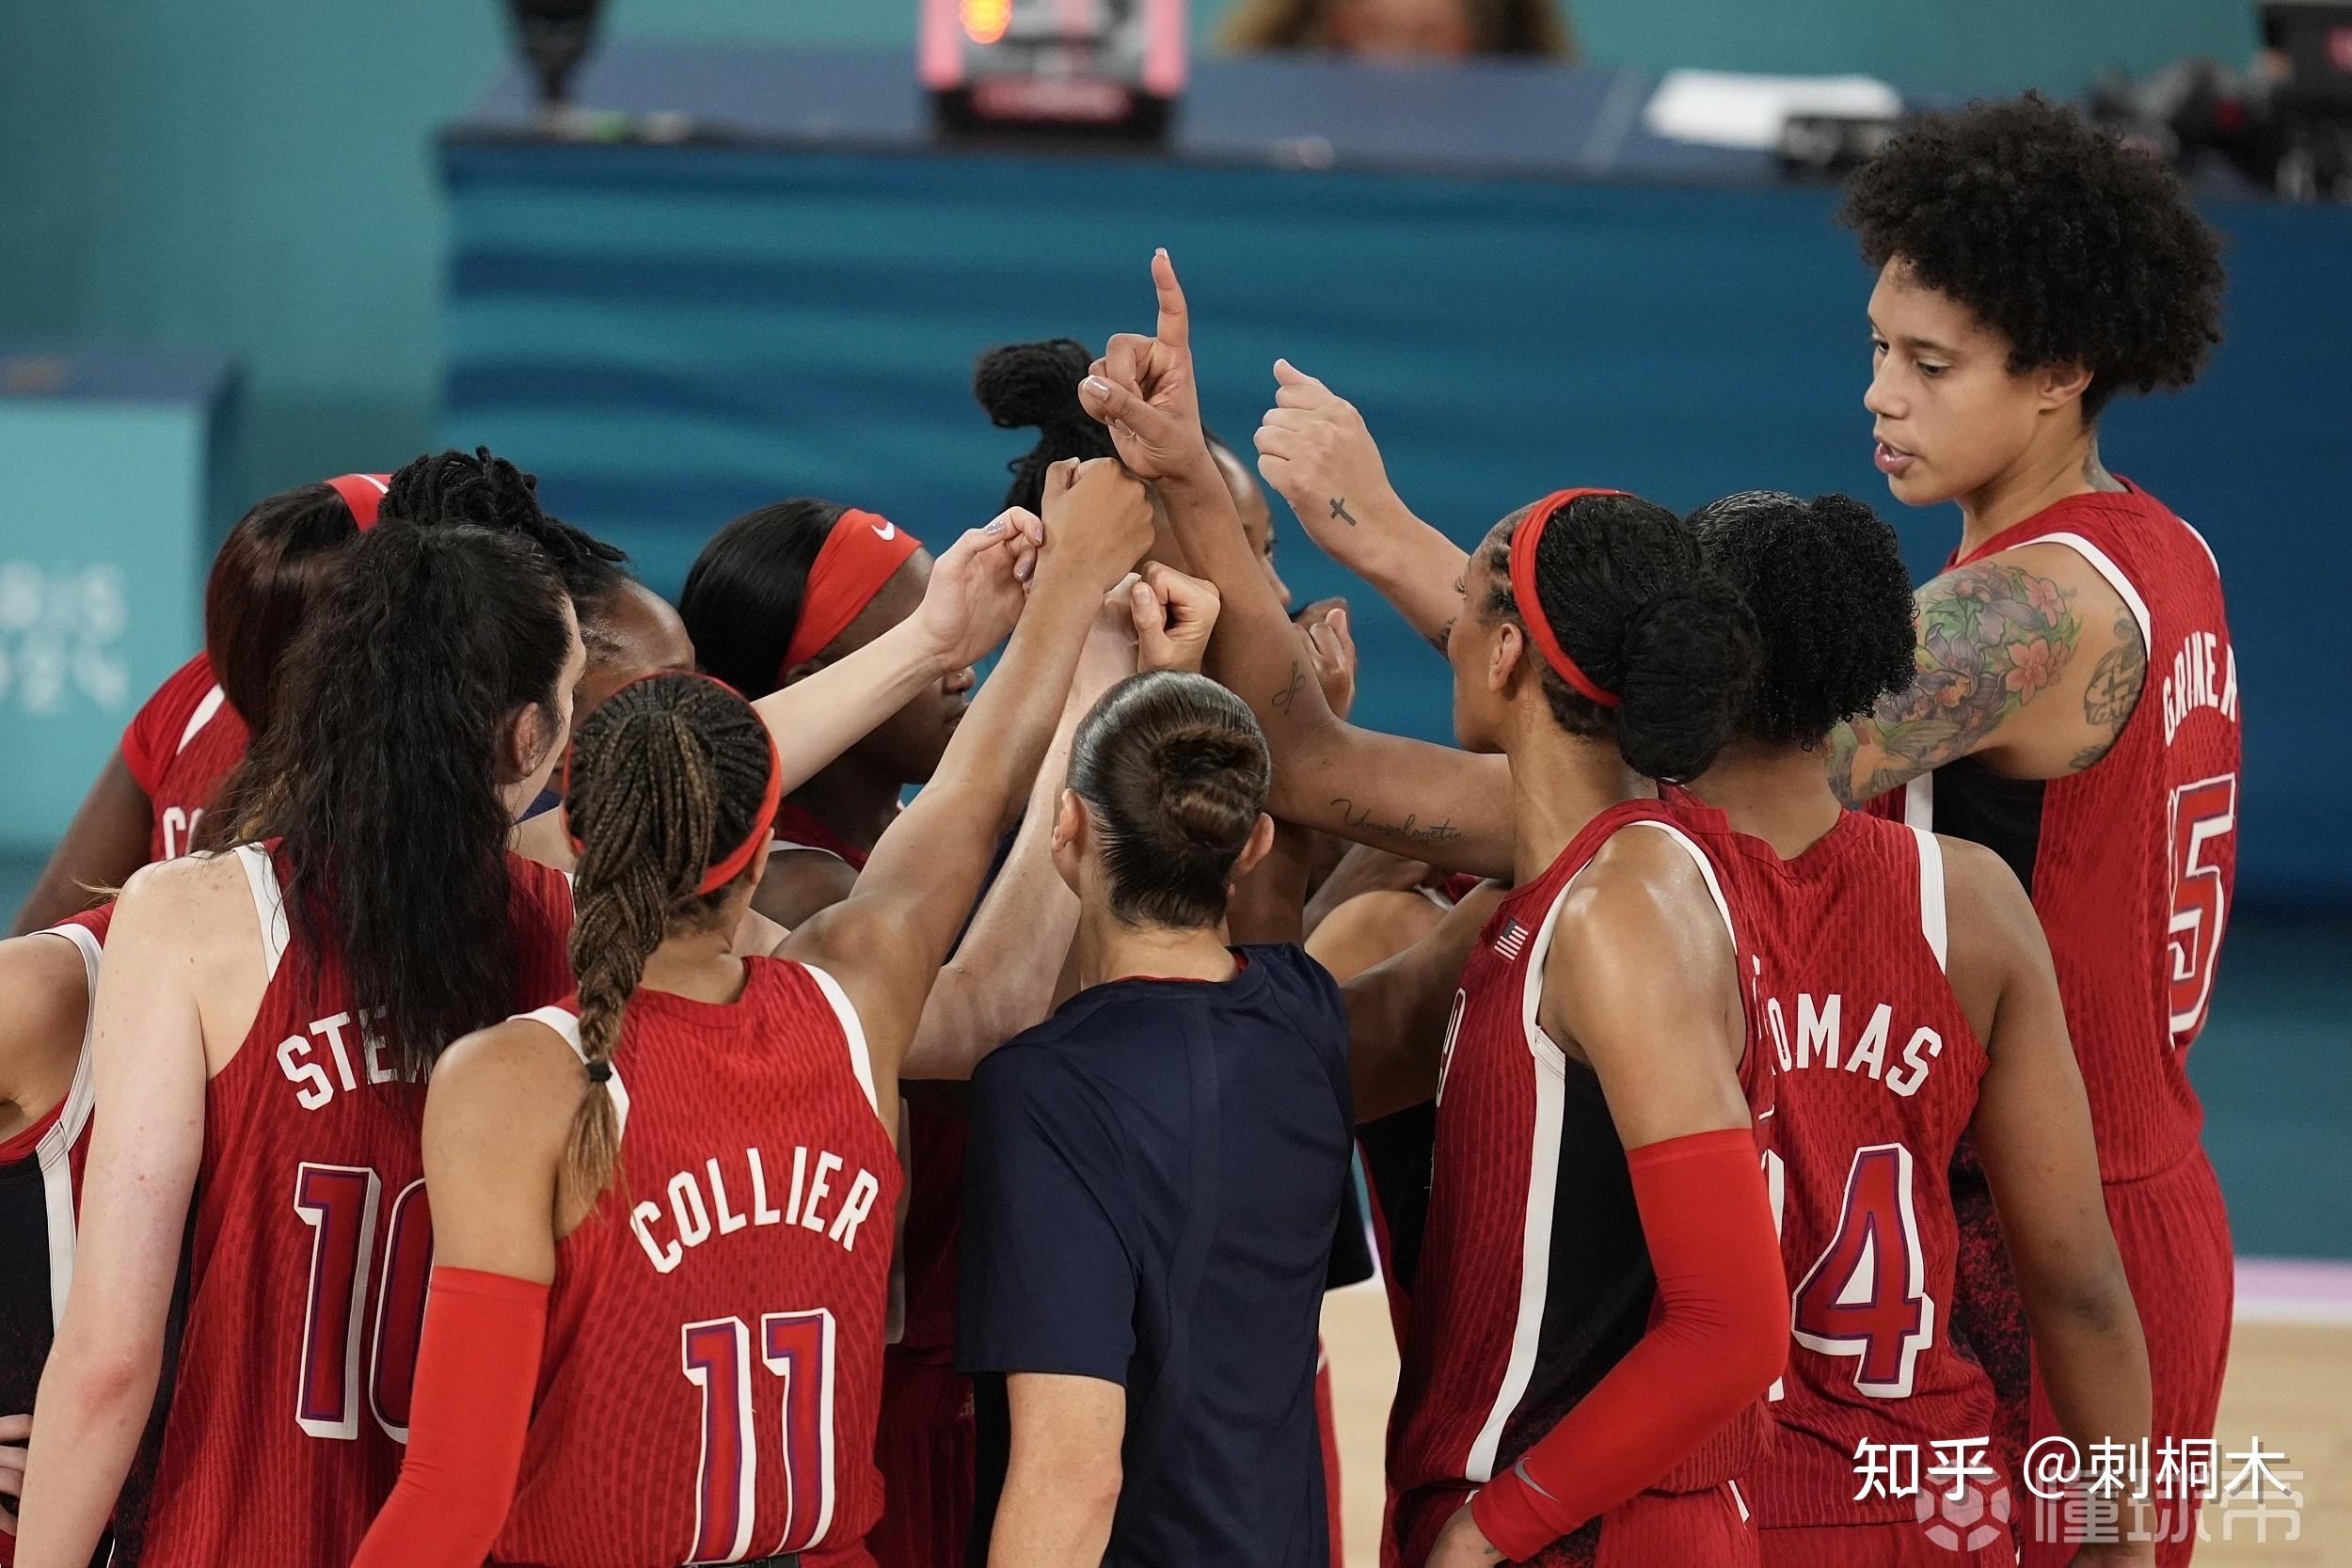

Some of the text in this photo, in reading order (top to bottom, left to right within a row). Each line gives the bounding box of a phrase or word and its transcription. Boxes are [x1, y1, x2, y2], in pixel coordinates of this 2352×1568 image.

[2163, 630, 2238, 747] GRINER
[2168, 772, 2236, 1051] 5
[1768, 993, 1943, 1097] OMAS
[629, 1146, 880, 1275] COLLIER
[681, 1307, 836, 1566] 11
